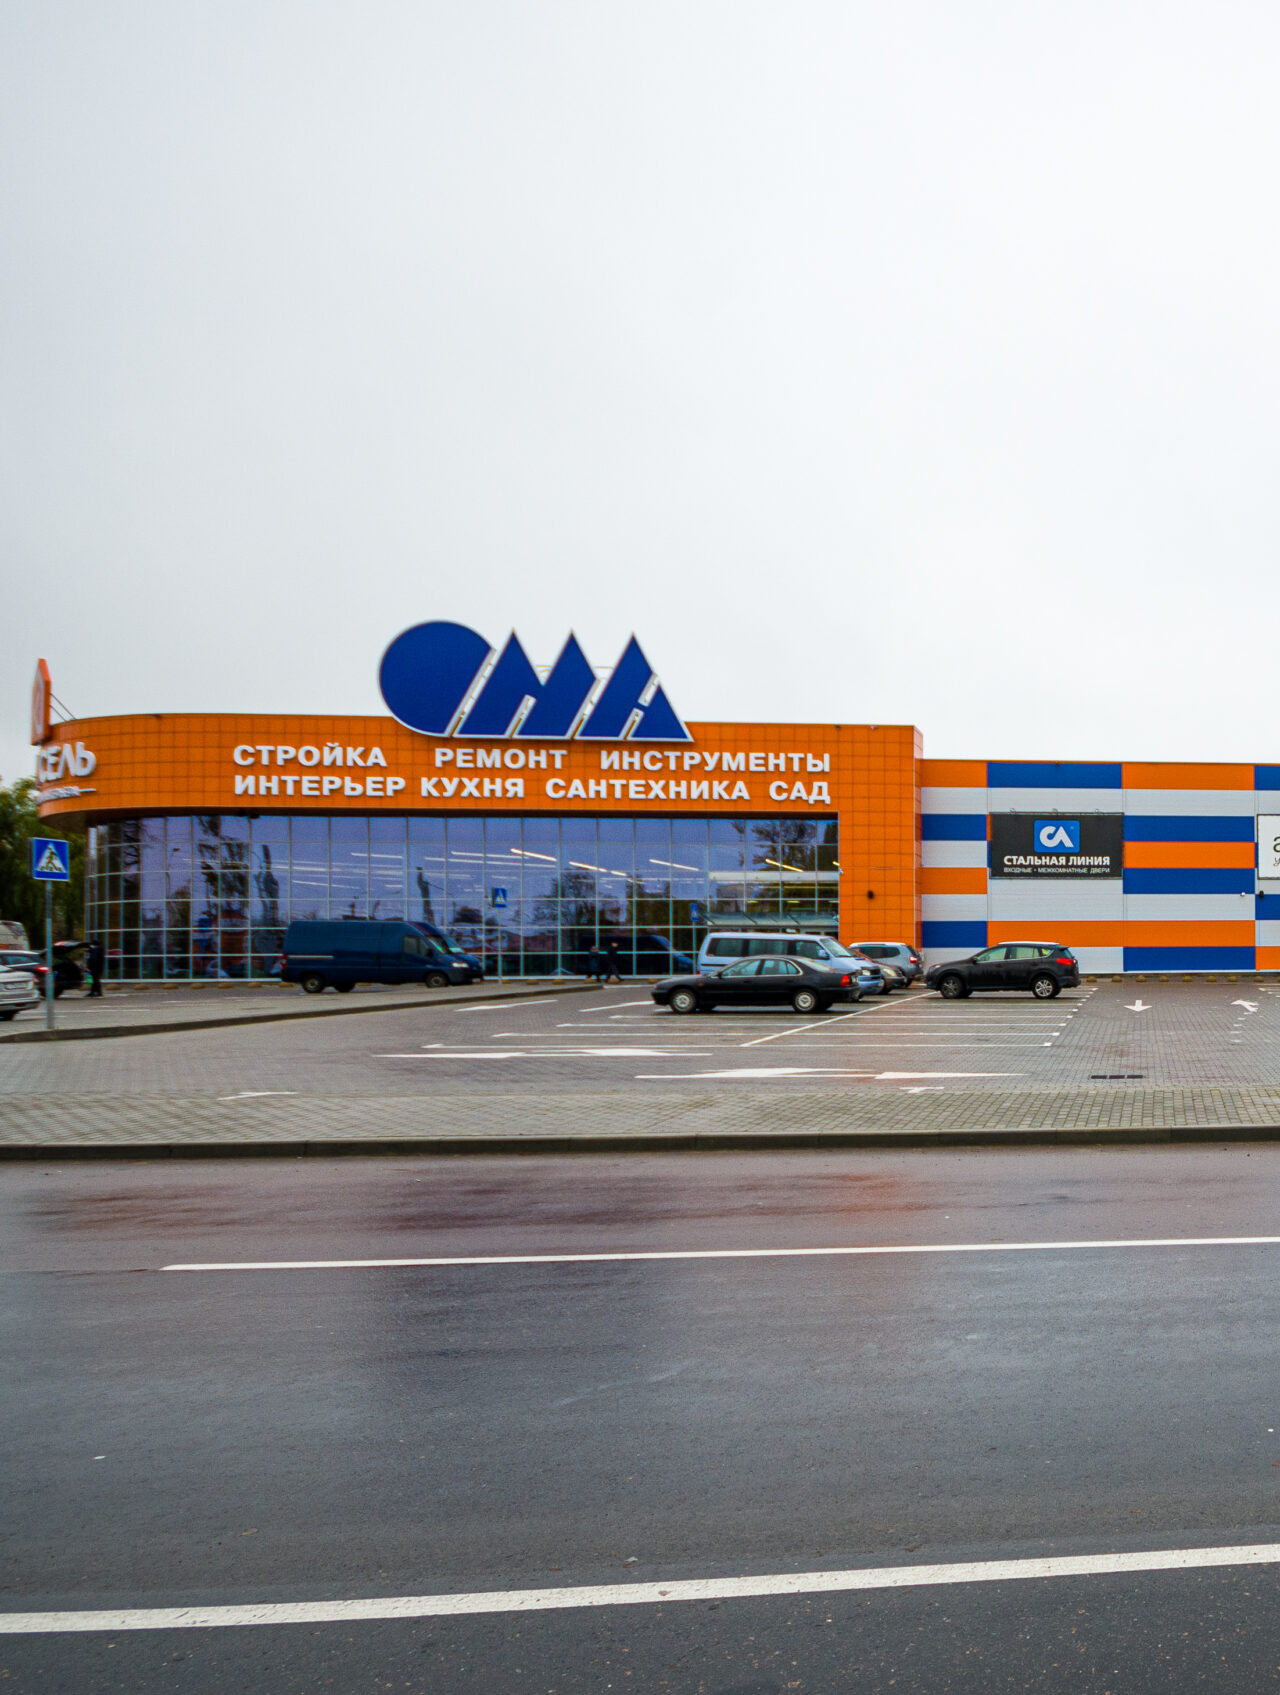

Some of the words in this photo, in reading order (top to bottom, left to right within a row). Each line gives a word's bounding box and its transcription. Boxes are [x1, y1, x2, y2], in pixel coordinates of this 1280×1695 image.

[233, 742, 387, 767] СТРОЙКА
[434, 748, 568, 769] РЕМОНТ
[600, 751, 831, 772] ИНСТРУМЕНТЫ
[234, 775, 406, 797] ИНТЕРЬЕР
[421, 777, 525, 798] КУХНЯ
[545, 779, 750, 800] САНТЕХНИКА
[769, 781, 831, 804] САД
[1003, 856, 1066, 866] СТАЛЬНАЯ
[1068, 856, 1110, 866] ЛИНИЯ
